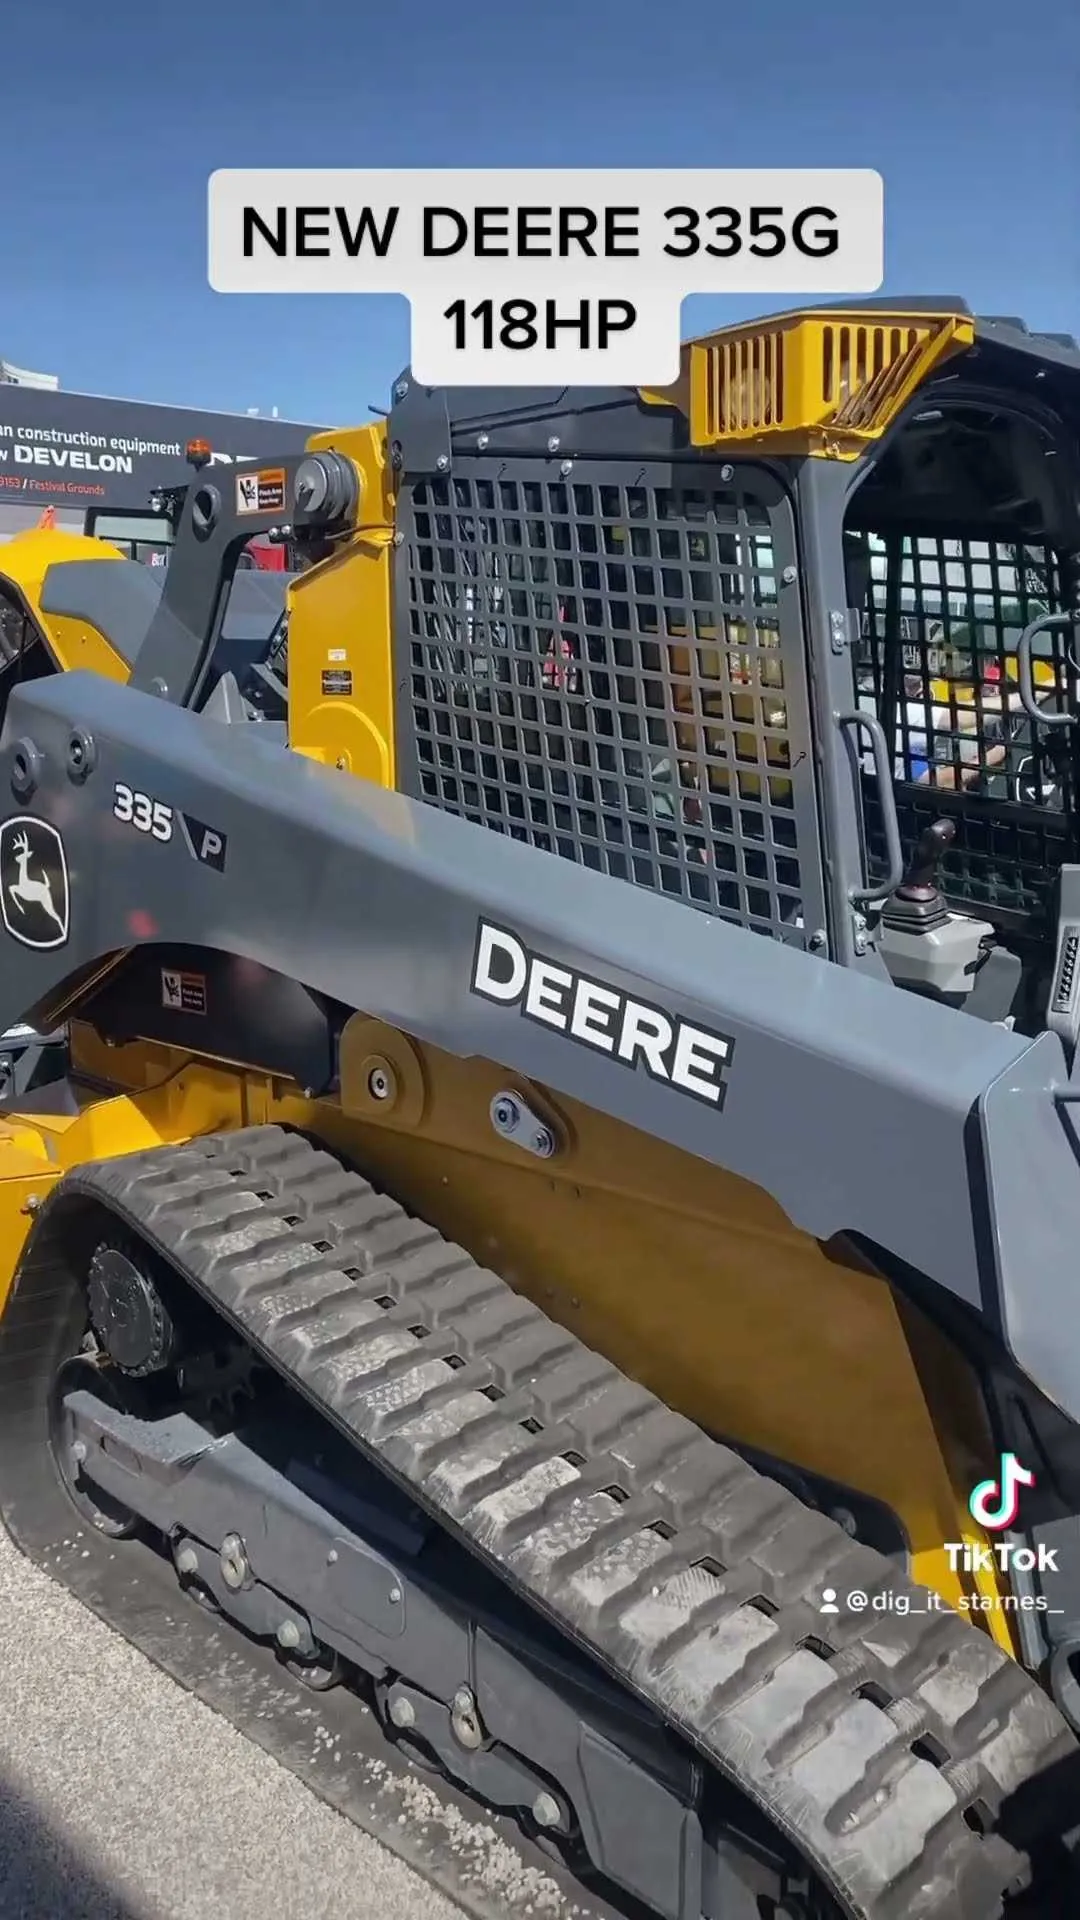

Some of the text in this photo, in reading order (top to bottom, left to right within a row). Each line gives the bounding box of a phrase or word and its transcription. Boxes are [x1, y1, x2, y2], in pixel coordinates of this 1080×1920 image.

[17, 427, 107, 448] construction
[110, 437, 181, 456] equipment
[14, 444, 133, 474] DEVELON
[29, 479, 65, 492] Festival
[66, 483, 105, 495] Grounds
[113, 783, 222, 859] 335 P
[474, 923, 729, 1102] DEERE
